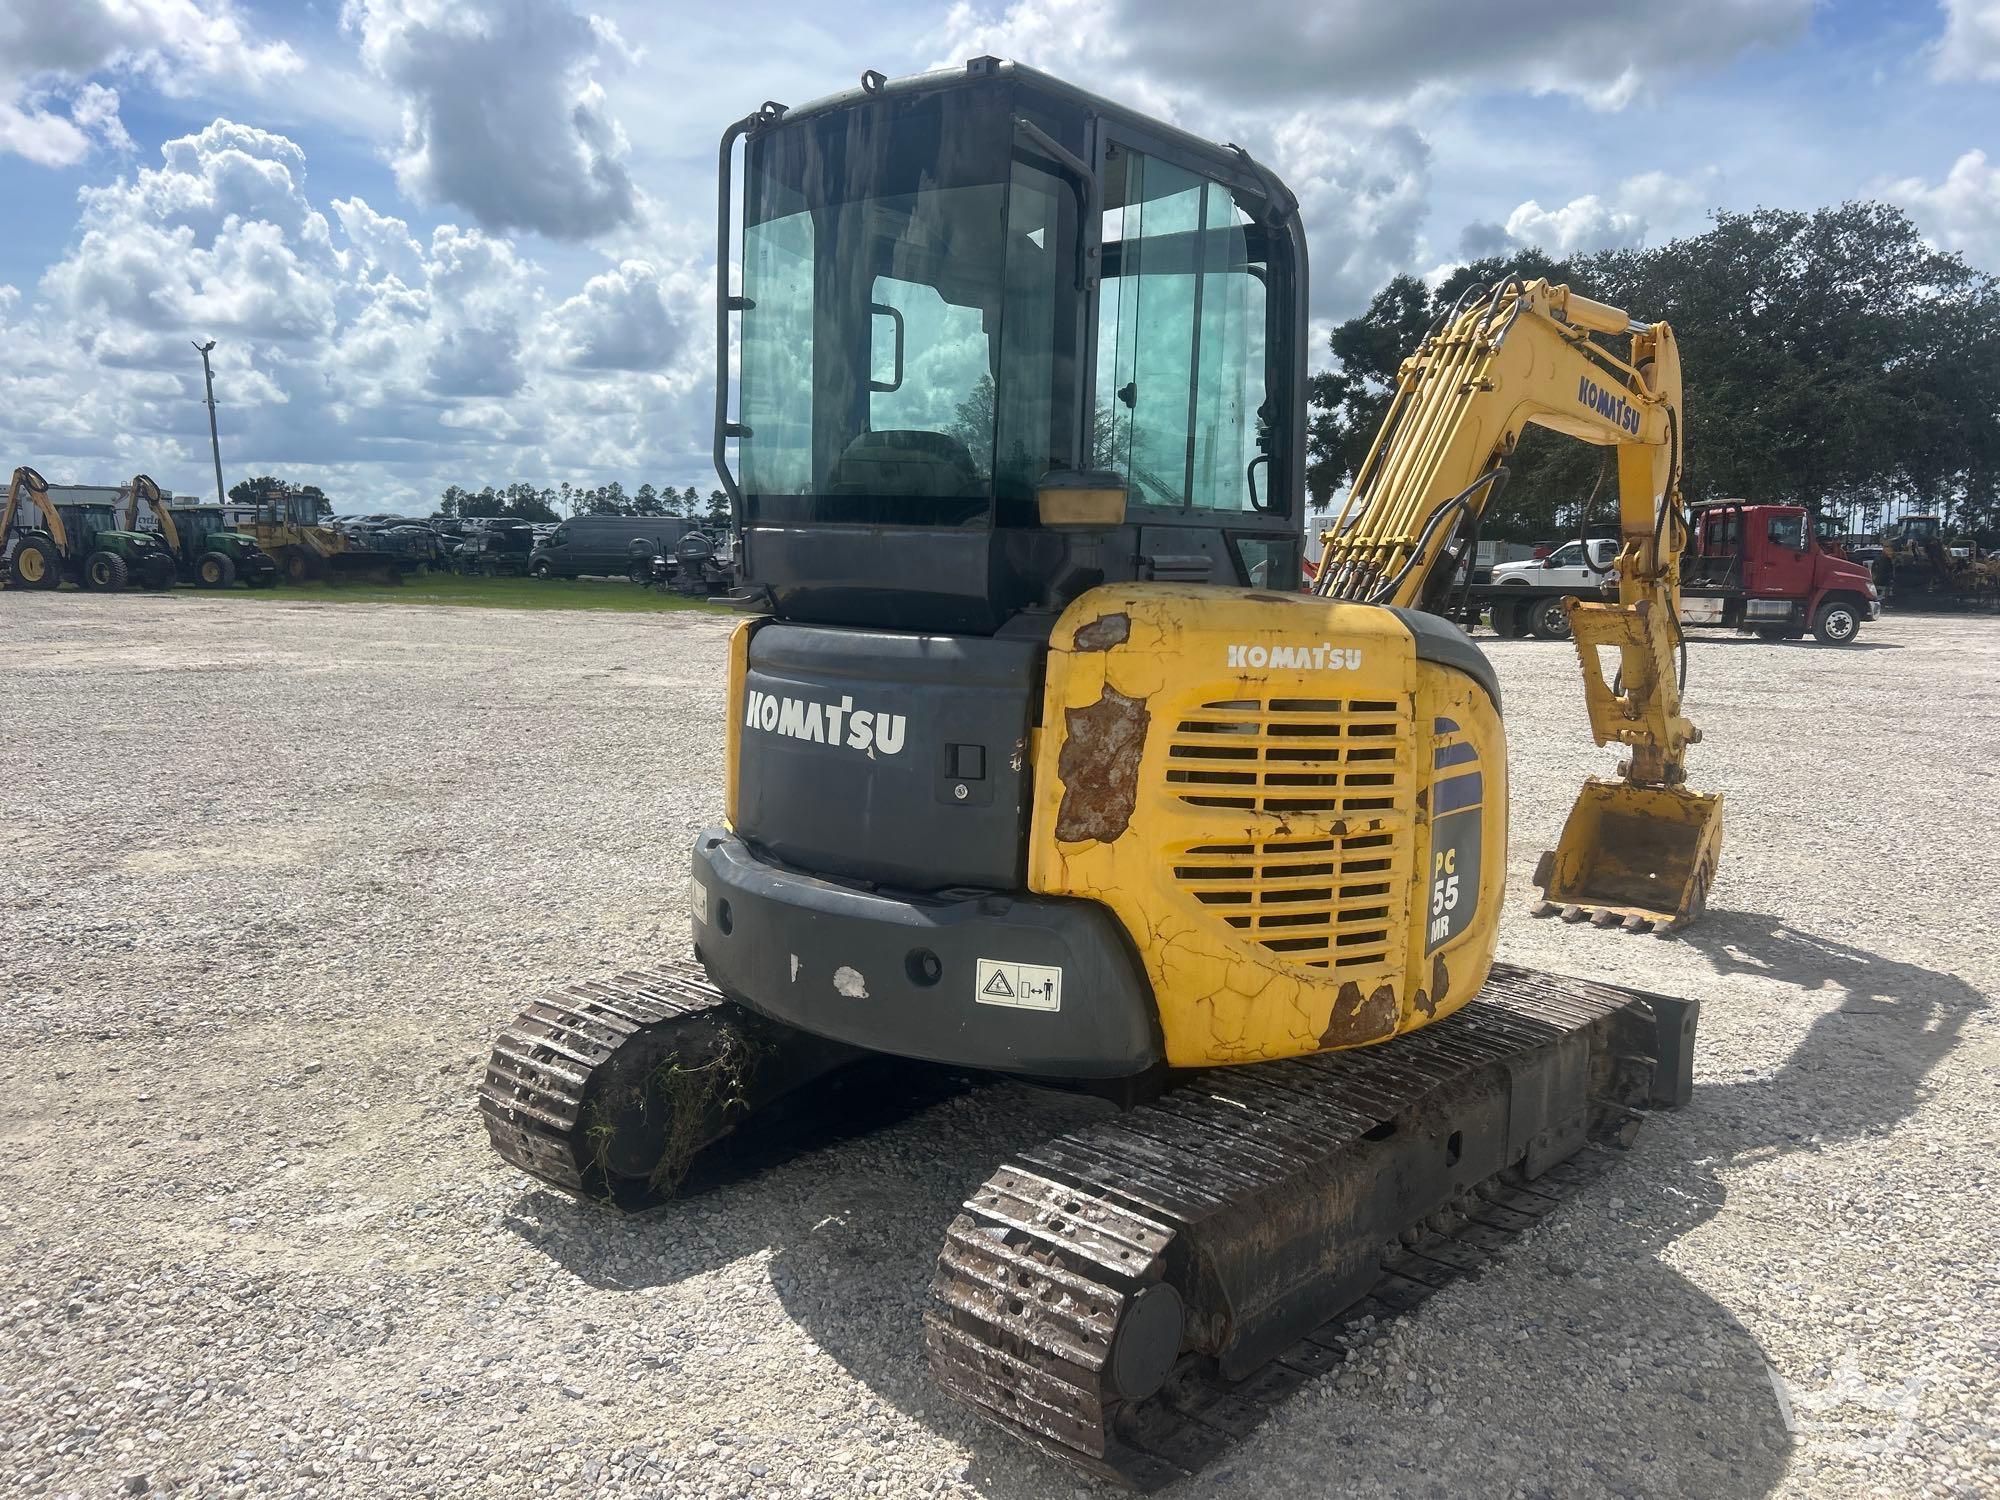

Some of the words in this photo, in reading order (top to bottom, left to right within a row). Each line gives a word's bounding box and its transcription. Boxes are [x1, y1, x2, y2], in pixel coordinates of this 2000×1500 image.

[1578, 375, 1641, 435] KOMATSU
[1227, 642, 1362, 671] KOMATSU
[746, 690, 906, 755] KOMATSU
[1434, 848, 1456, 880] PC
[1432, 876, 1460, 916] 55
[1430, 915, 1449, 944] MR
